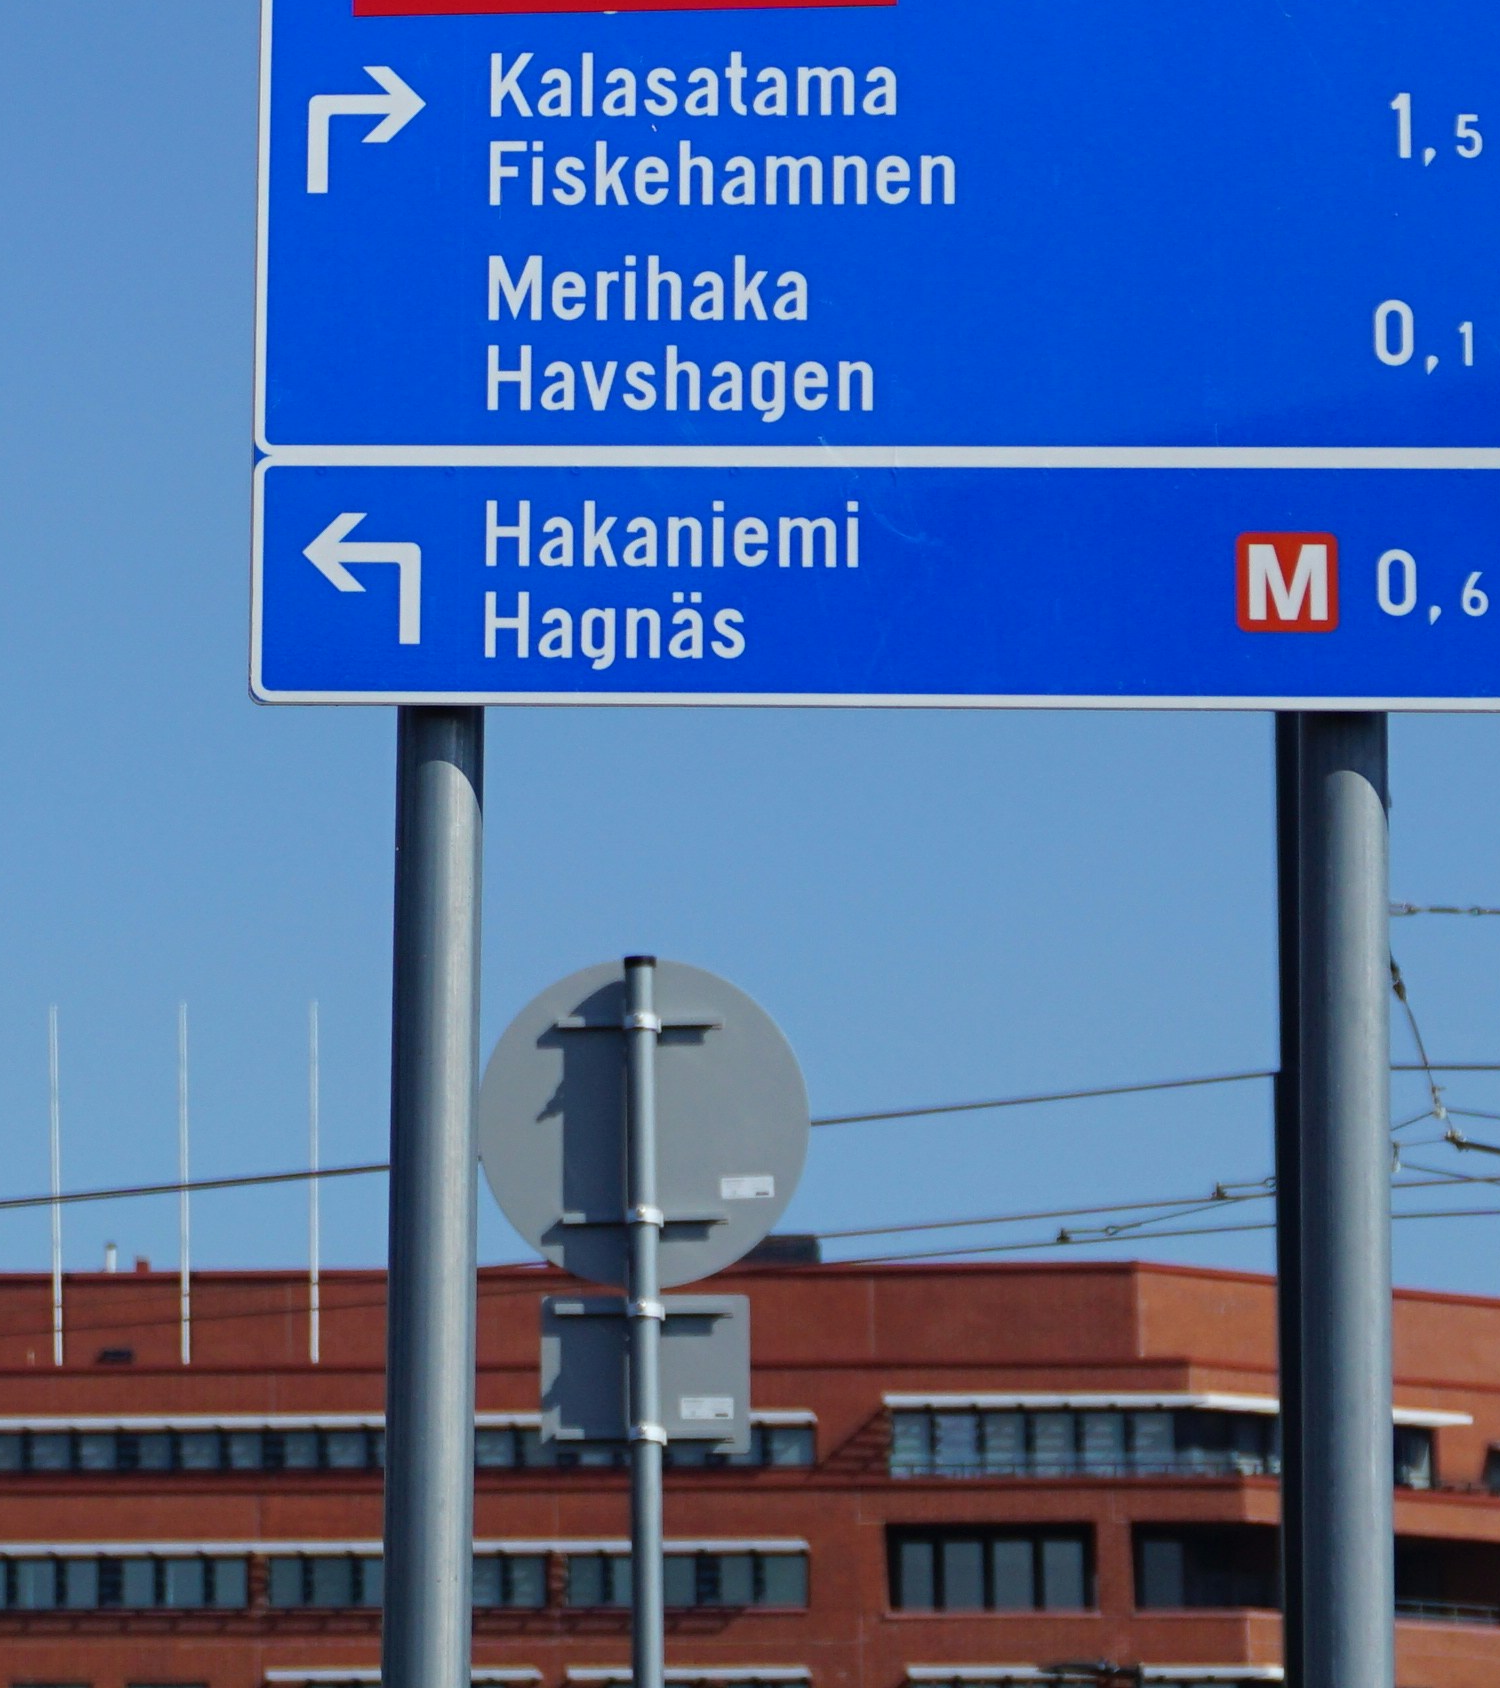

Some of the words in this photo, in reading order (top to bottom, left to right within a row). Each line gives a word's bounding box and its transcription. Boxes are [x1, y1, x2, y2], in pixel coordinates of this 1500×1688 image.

[490, 51, 898, 118] Kalasatama
[1391, 92, 1484, 165] 1,5
[489, 139, 957, 206] Fiskehamnen
[488, 254, 809, 321] Merihaka
[1374, 299, 1475, 373] 0,1
[486, 343, 875, 424] Havshagen
[485, 499, 861, 569] Hakaniemi
[1248, 543, 1328, 621] M
[1376, 548, 1490, 624] 0,6
[484, 590, 747, 671] Hagnäs
